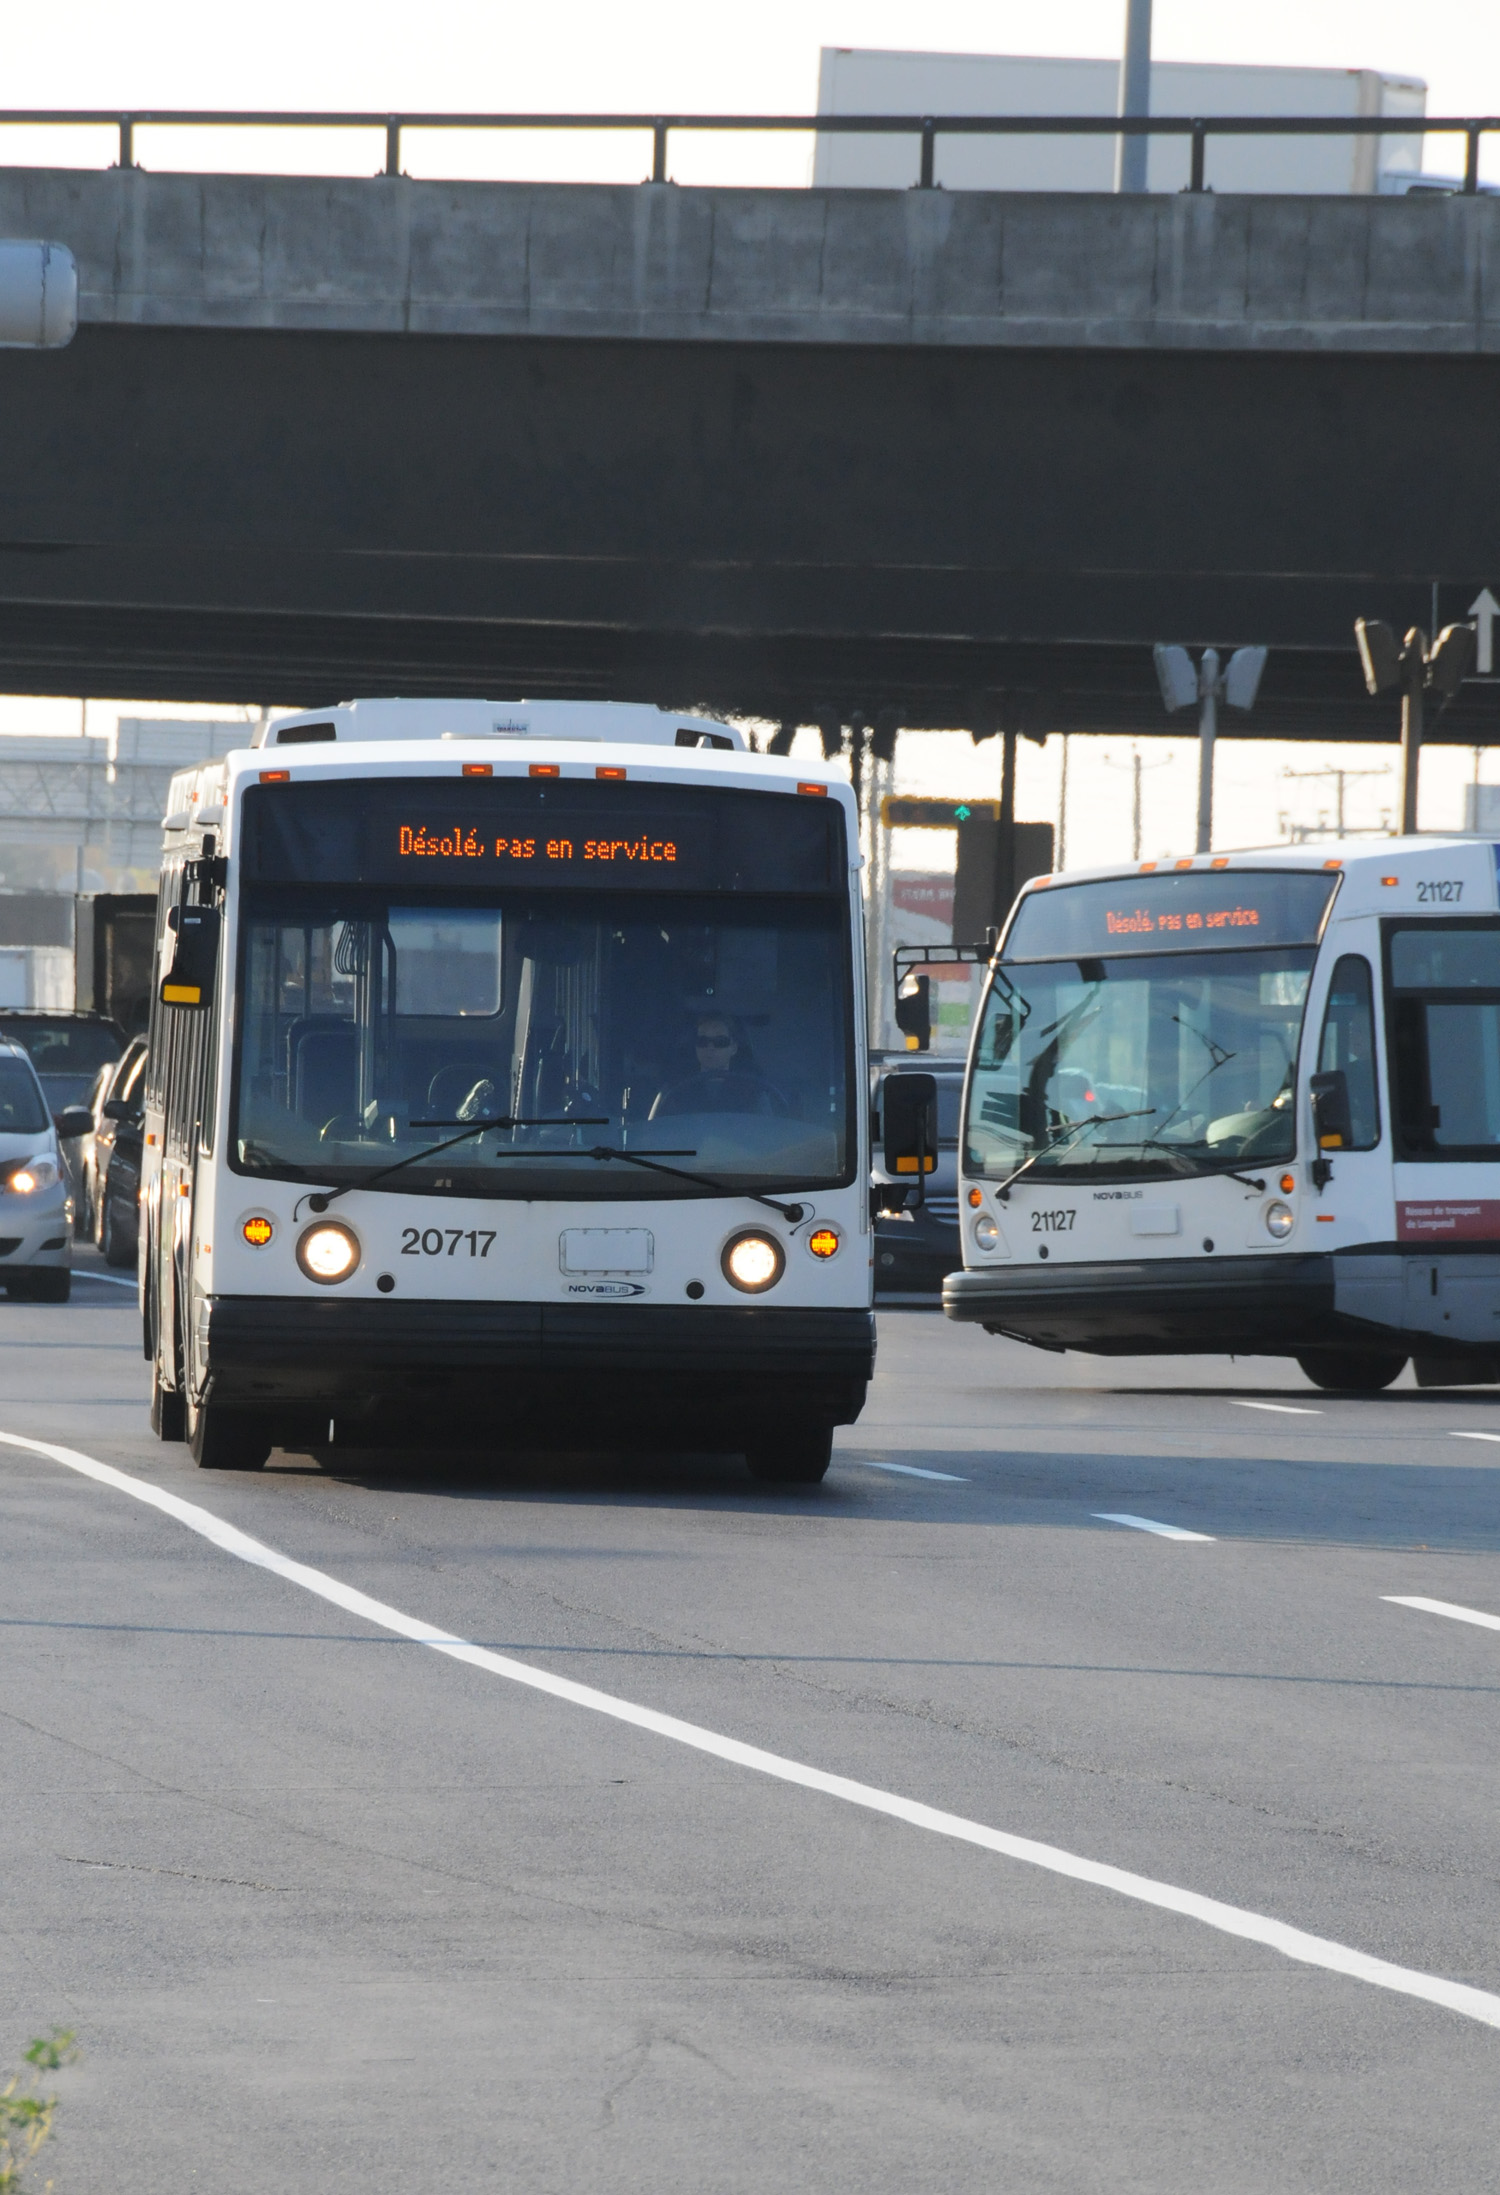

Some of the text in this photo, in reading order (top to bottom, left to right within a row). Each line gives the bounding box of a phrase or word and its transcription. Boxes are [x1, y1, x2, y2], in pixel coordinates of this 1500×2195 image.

[400, 826, 676, 861] Désolé, pas en service
[1416, 880, 1464, 903] 21127
[1205, 906, 1260, 928] service
[1031, 1209, 1077, 1232] 21127
[401, 1228, 497, 1257] 20717
